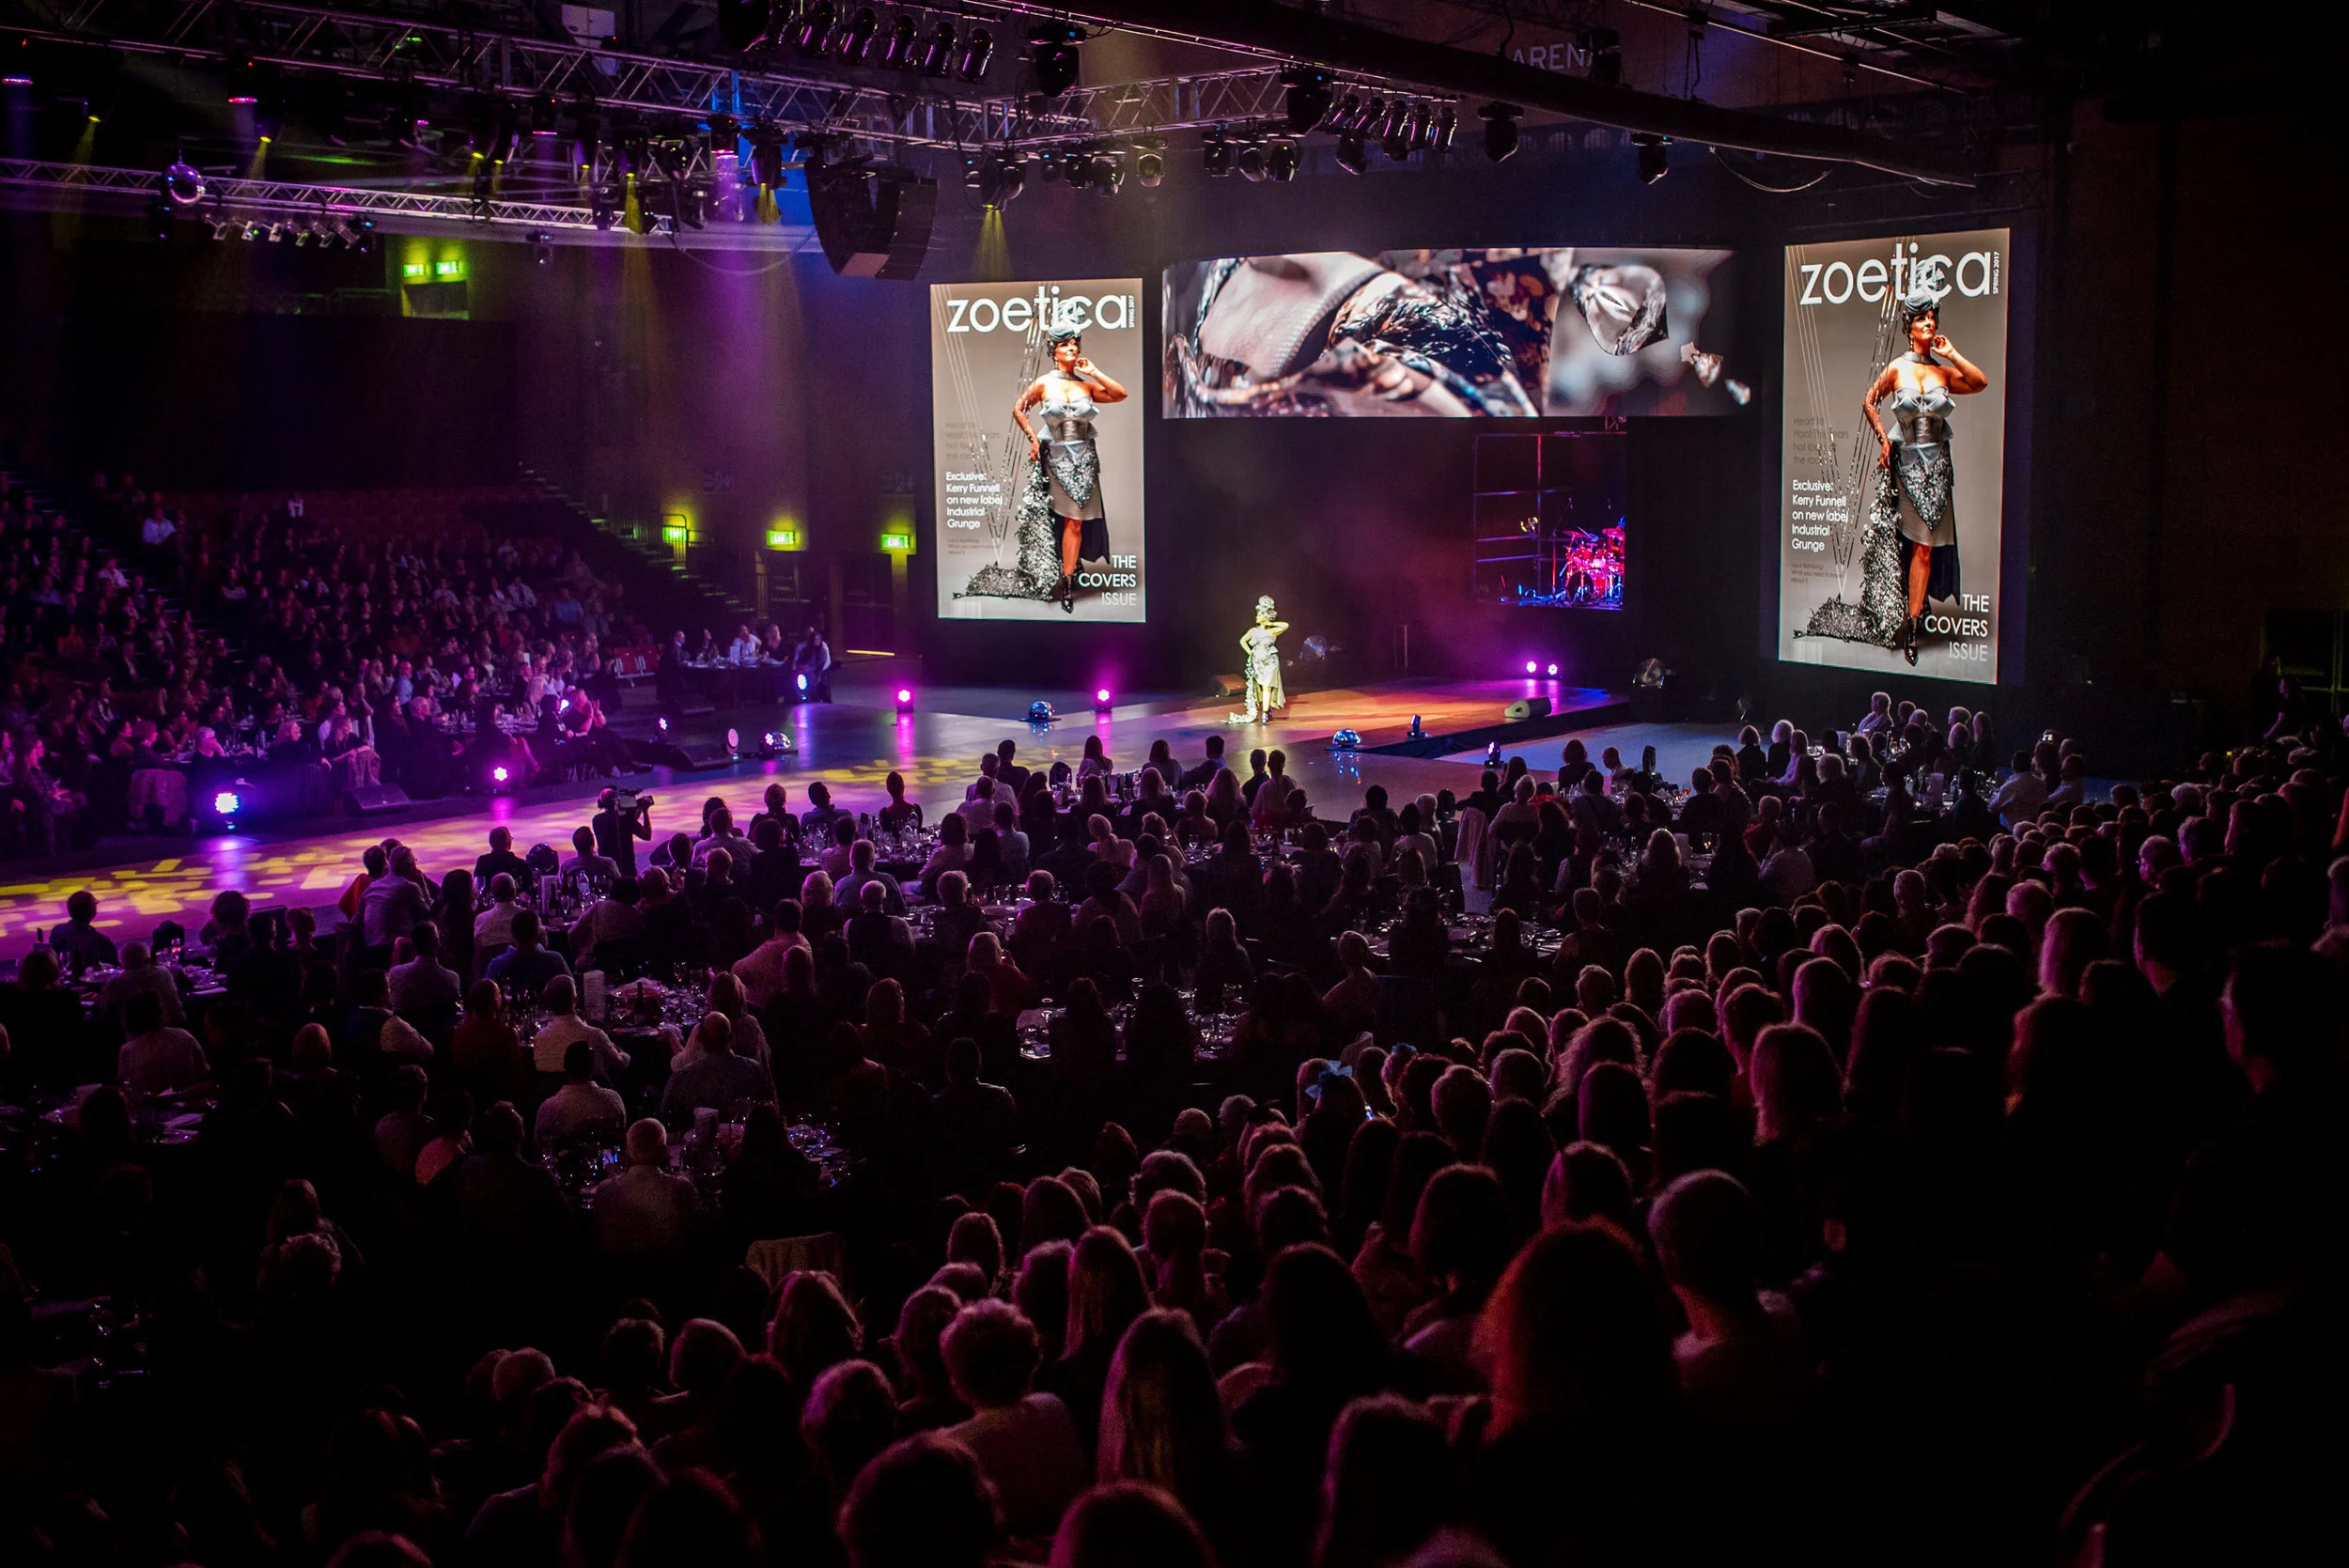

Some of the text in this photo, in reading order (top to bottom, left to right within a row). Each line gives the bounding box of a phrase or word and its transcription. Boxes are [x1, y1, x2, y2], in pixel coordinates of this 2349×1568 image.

[1513, 42, 1594, 70] AREN
[1799, 241, 1991, 305] zoetica
[946, 285, 1128, 333] zoetica
[945, 472, 988, 481] Exclusive:
[945, 483, 1001, 494] Kerry Funnell
[1792, 479, 1833, 491] Exclusive:
[946, 494, 1003, 505] on new label
[1792, 494, 1847, 507] Kerry Funnell
[946, 506, 986, 517] Industrial
[1792, 508, 1849, 523] on new label
[946, 518, 981, 530] Grunge
[1791, 523, 1830, 536] Industrial
[1791, 537, 1826, 553] Grunge
[1112, 554, 1137, 568] THE
[1078, 572, 1137, 587] COVERS
[1101, 592, 1137, 606] ISSUE
[1962, 594, 1990, 613] THE
[1924, 614, 1988, 637] COVERS
[1949, 641, 1988, 661] ISSUE
